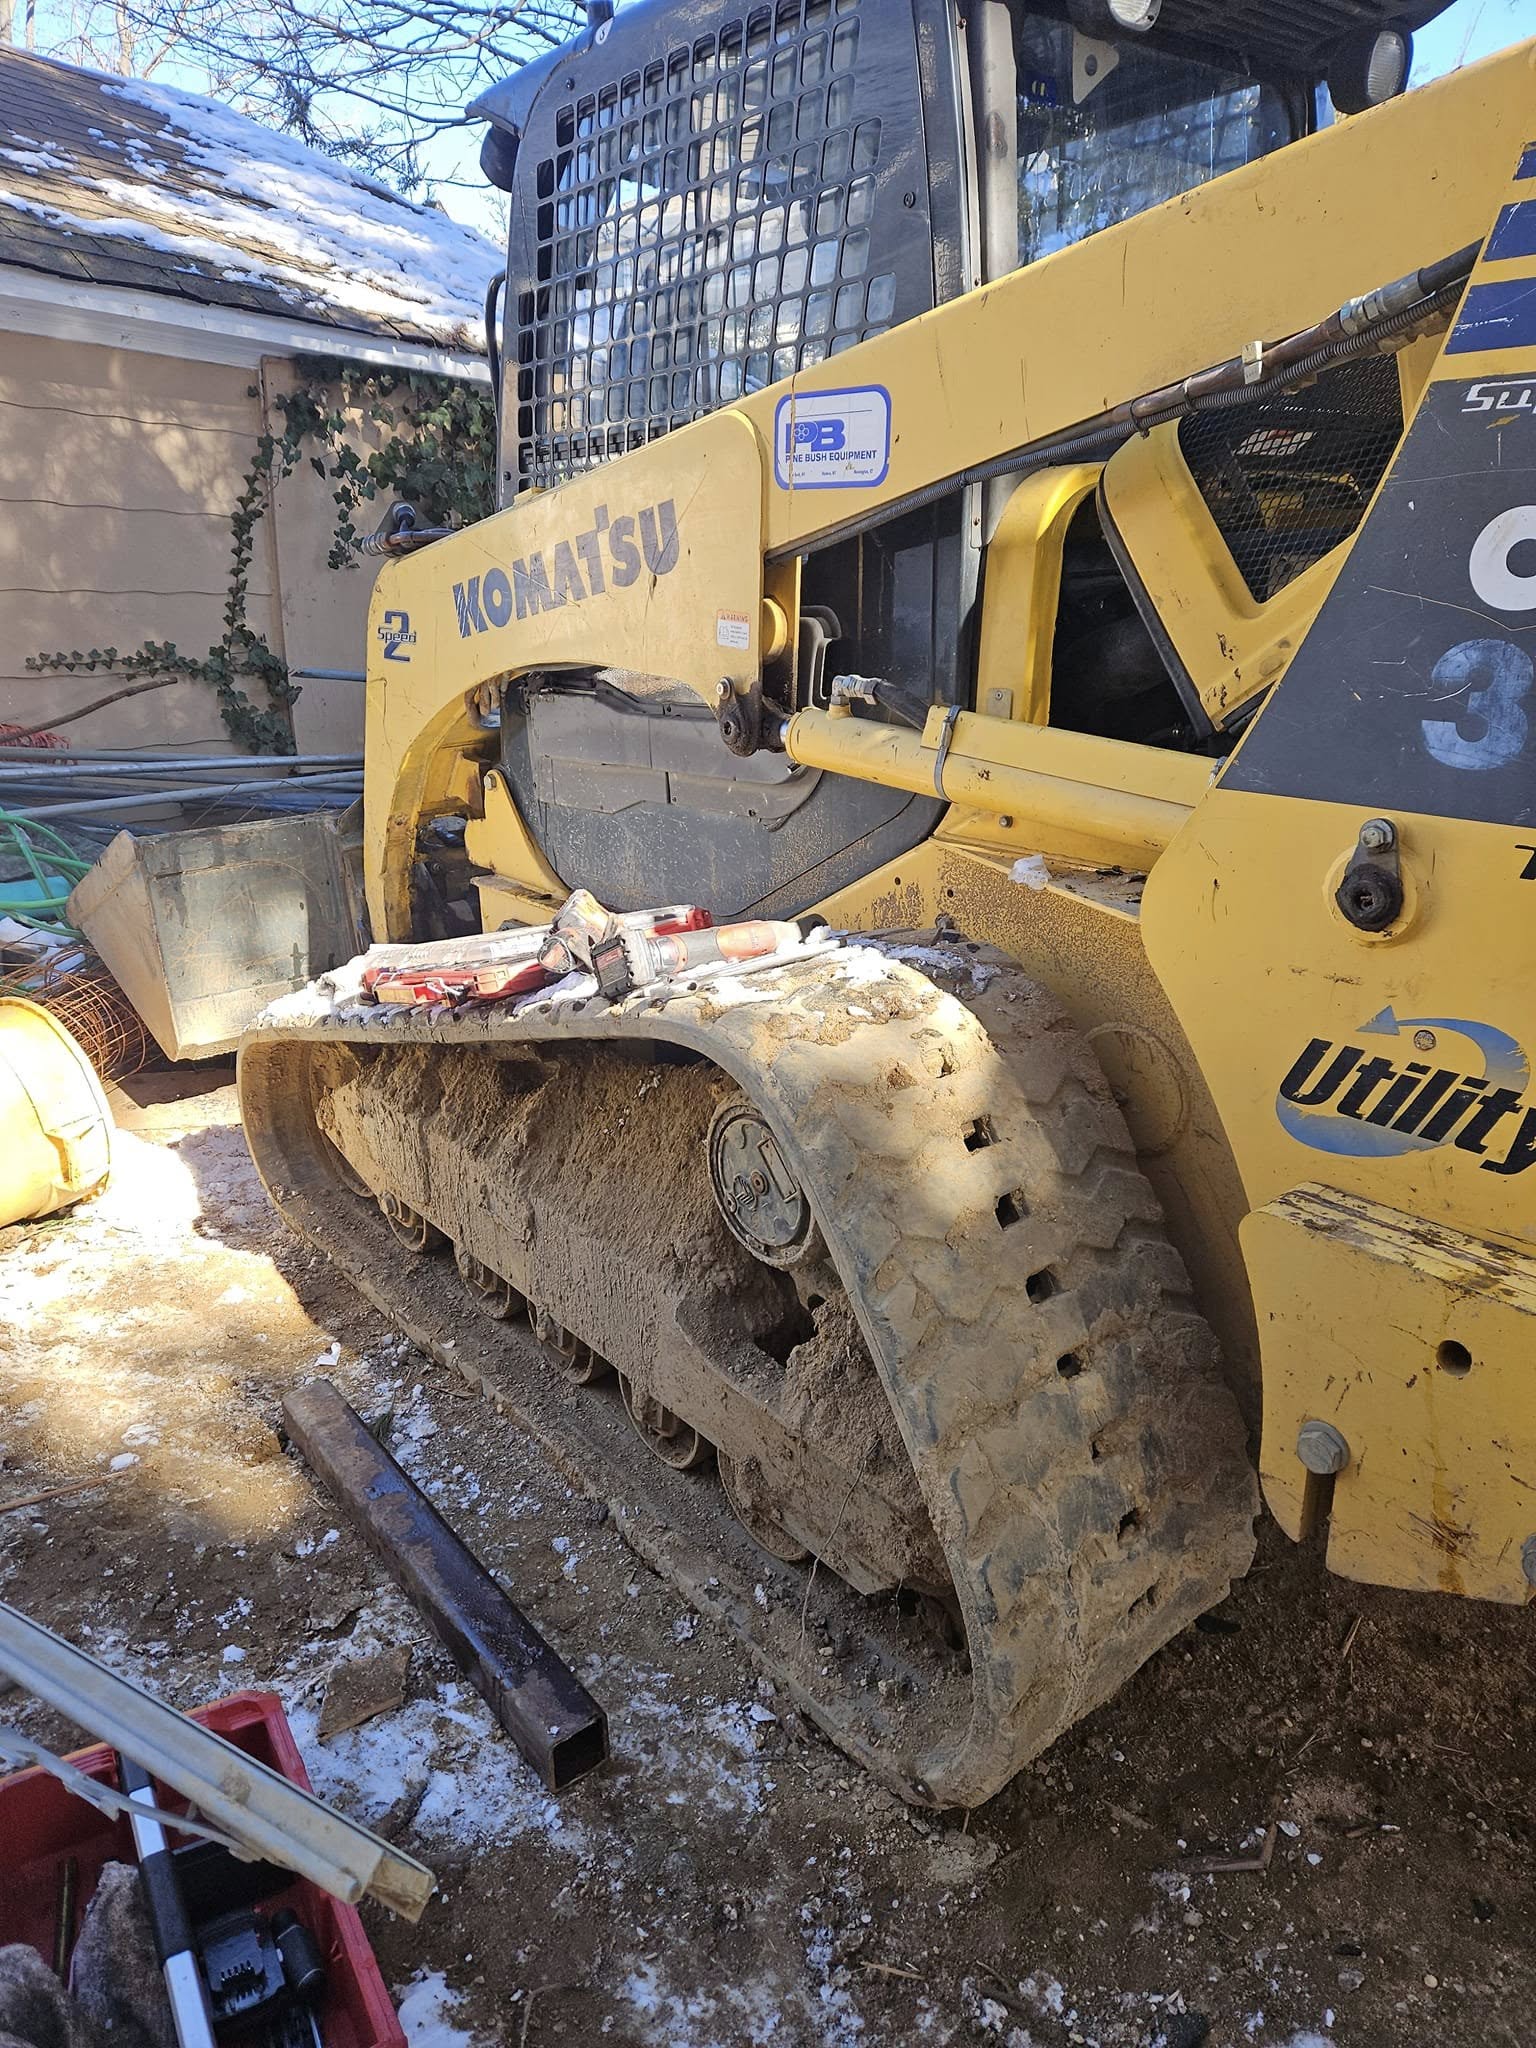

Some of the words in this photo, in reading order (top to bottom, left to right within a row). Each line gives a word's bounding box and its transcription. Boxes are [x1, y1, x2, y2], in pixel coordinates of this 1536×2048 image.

[1461, 379, 1536, 414] Su
[785, 419, 846, 454] PB
[805, 452, 827, 462] BUSH
[829, 449, 877, 461] EQUIPMENT
[452, 498, 680, 639] KOMATSU
[377, 627, 417, 645] Speed
[1421, 638, 1535, 770] 3
